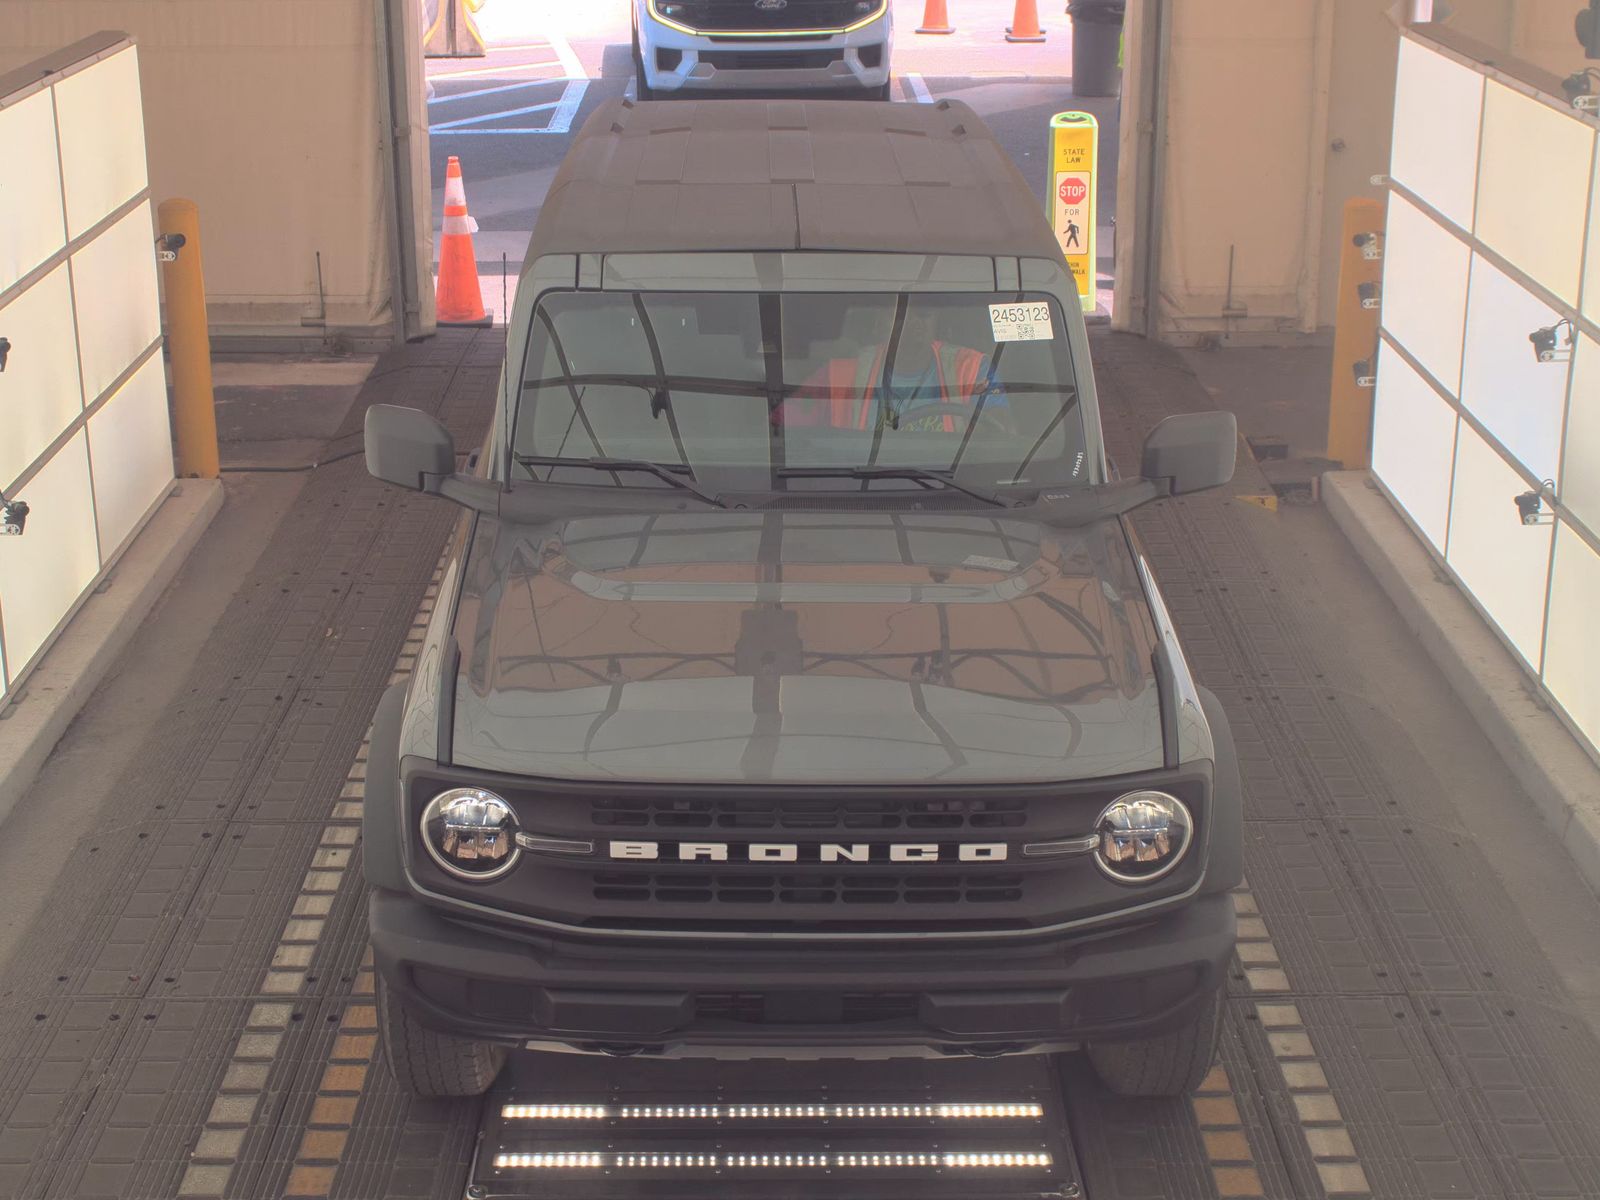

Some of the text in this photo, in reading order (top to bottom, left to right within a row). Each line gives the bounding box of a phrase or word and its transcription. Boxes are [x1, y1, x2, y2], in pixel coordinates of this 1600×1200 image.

[1063, 148, 1086, 156] STATE
[1060, 185, 1085, 197] STOP
[1064, 208, 1080, 216] FOR
[991, 306, 1050, 323] 2453123
[608, 840, 1009, 859] BRONCO
